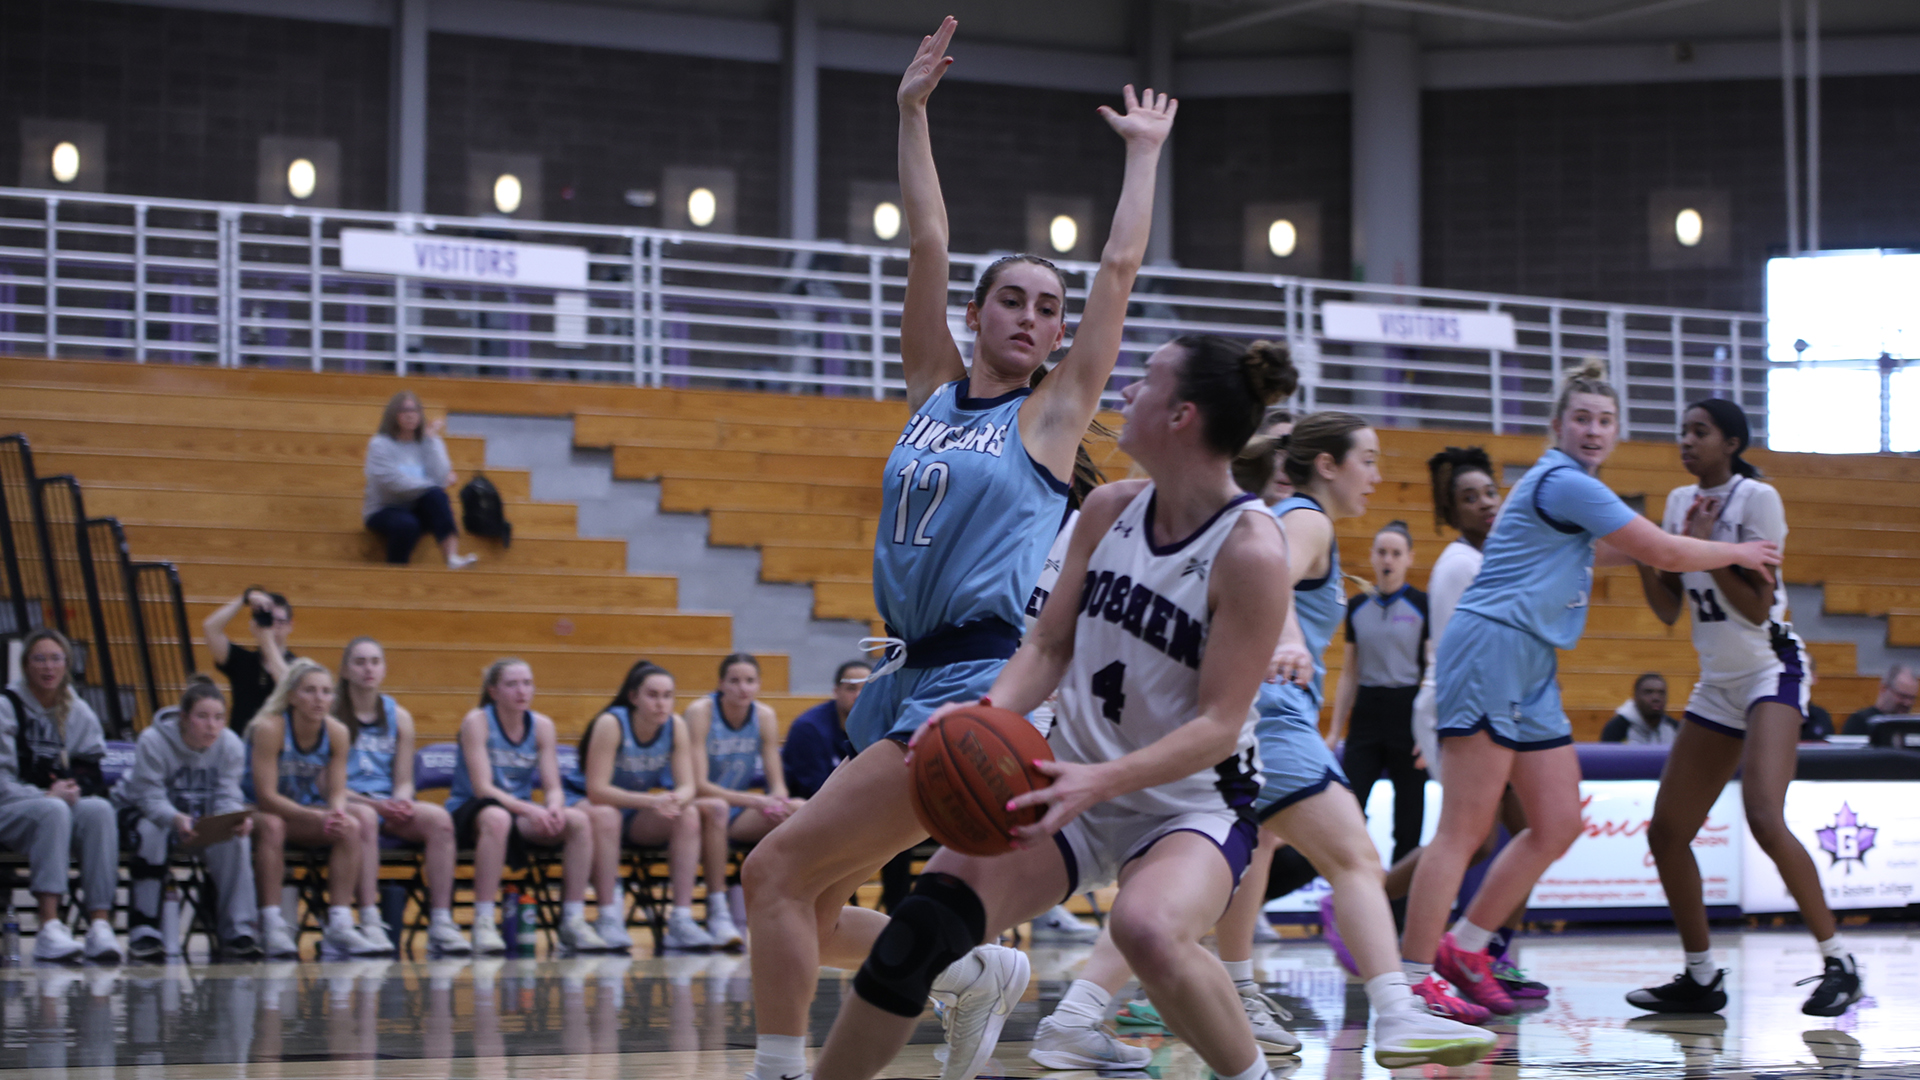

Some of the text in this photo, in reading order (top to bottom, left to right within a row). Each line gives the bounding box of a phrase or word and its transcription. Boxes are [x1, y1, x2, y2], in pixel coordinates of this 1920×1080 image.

[414, 242, 517, 278] VISITORS
[1378, 313, 1461, 342] VISITORS
[892, 458, 949, 547] 12
[1091, 660, 1126, 726] 4
